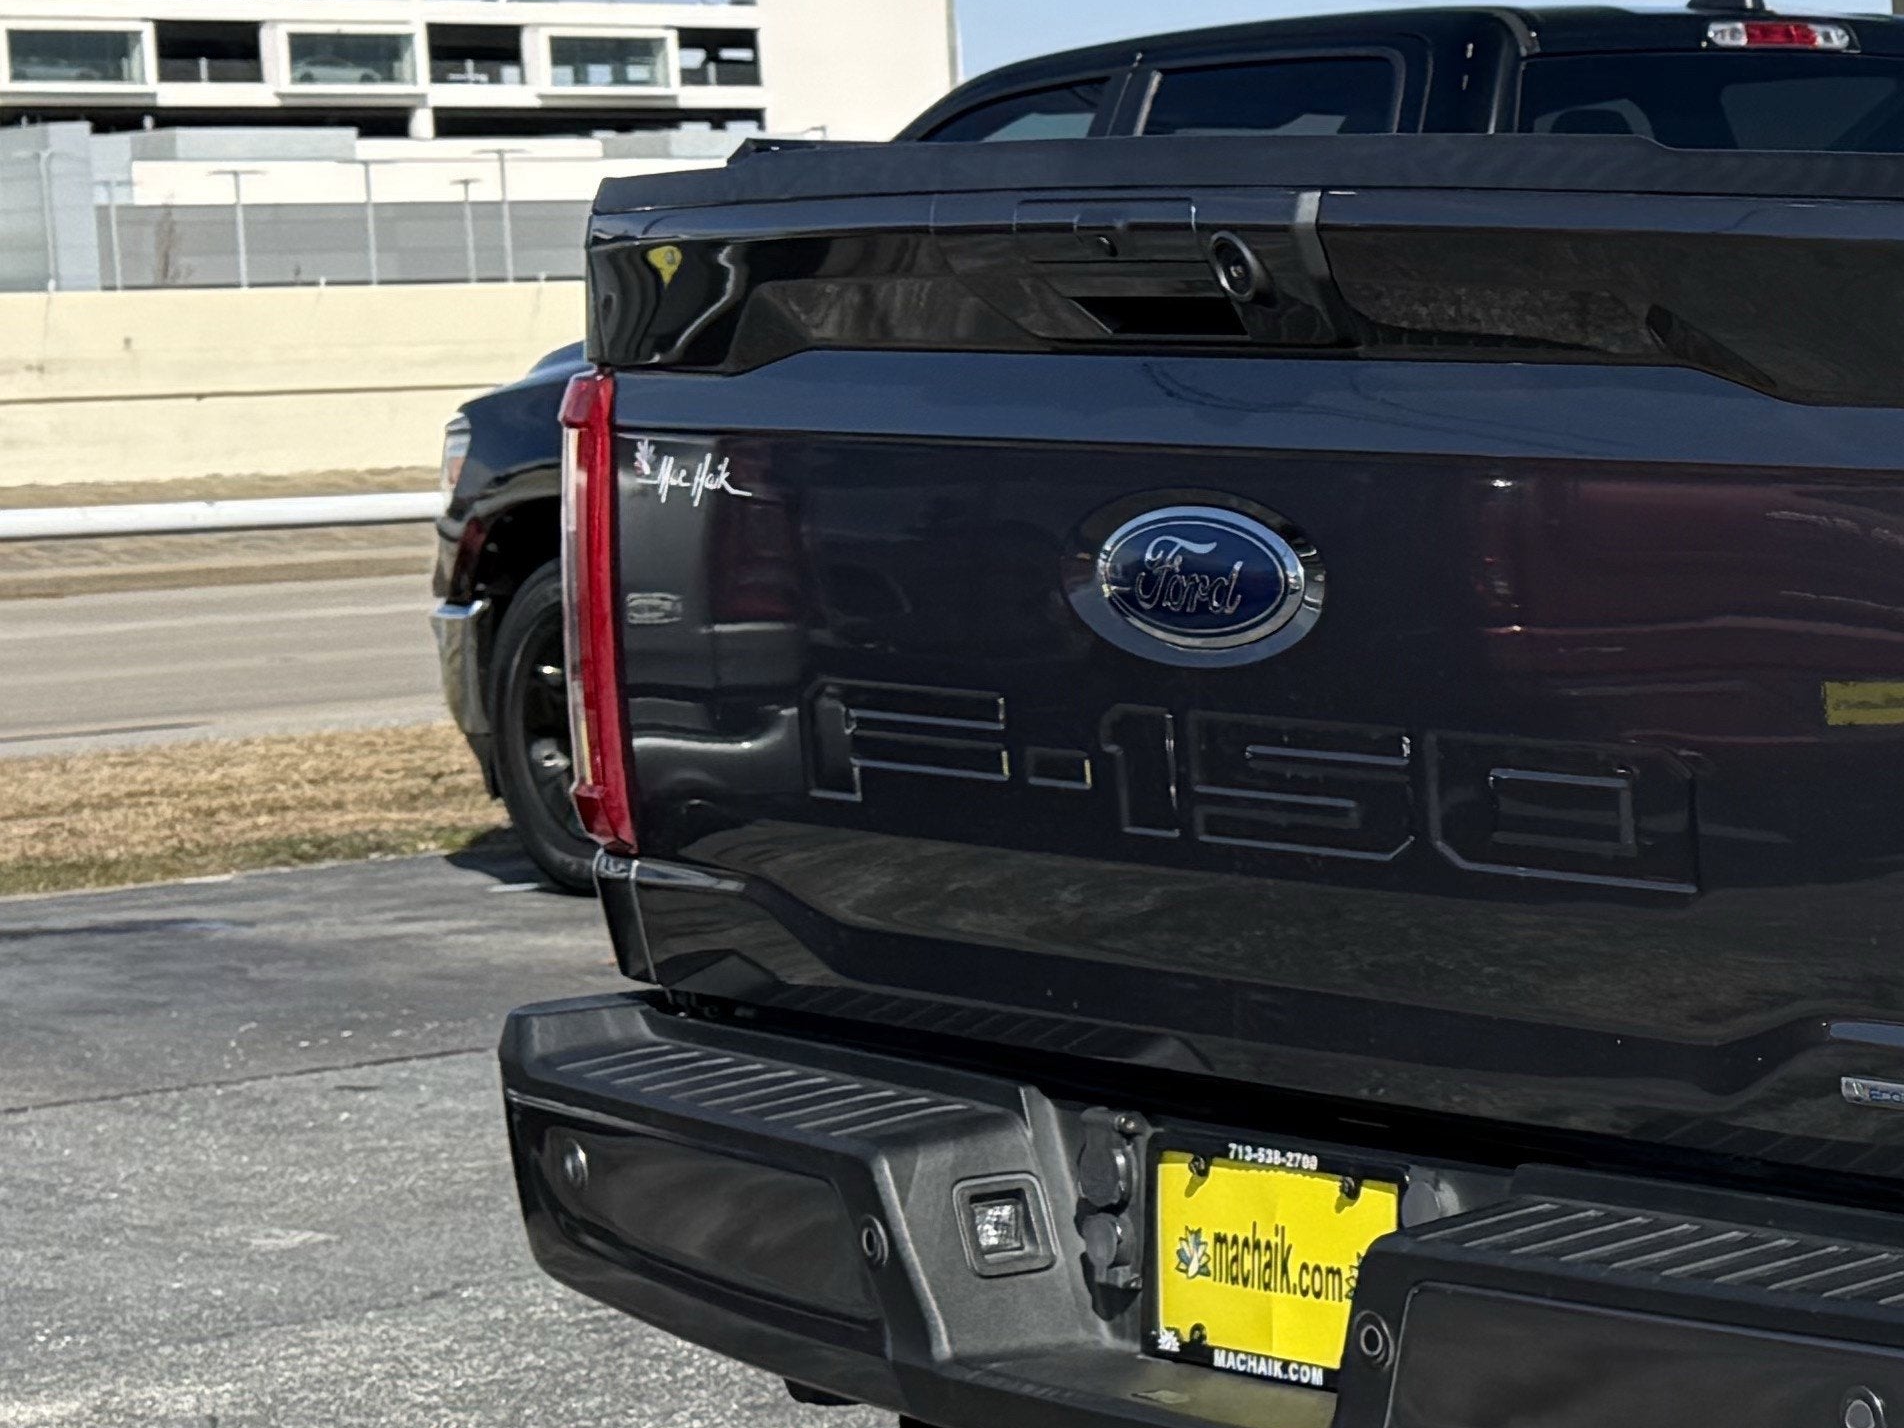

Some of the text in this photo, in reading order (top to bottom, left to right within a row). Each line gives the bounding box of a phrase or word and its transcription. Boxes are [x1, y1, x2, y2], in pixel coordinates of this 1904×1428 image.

[1135, 535, 1244, 615] Ford
[807, 677, 1699, 895] F-150
[1212, 1220, 1344, 1303] machaik.com
[1212, 1348, 1324, 1387] MACHAIK.COM
